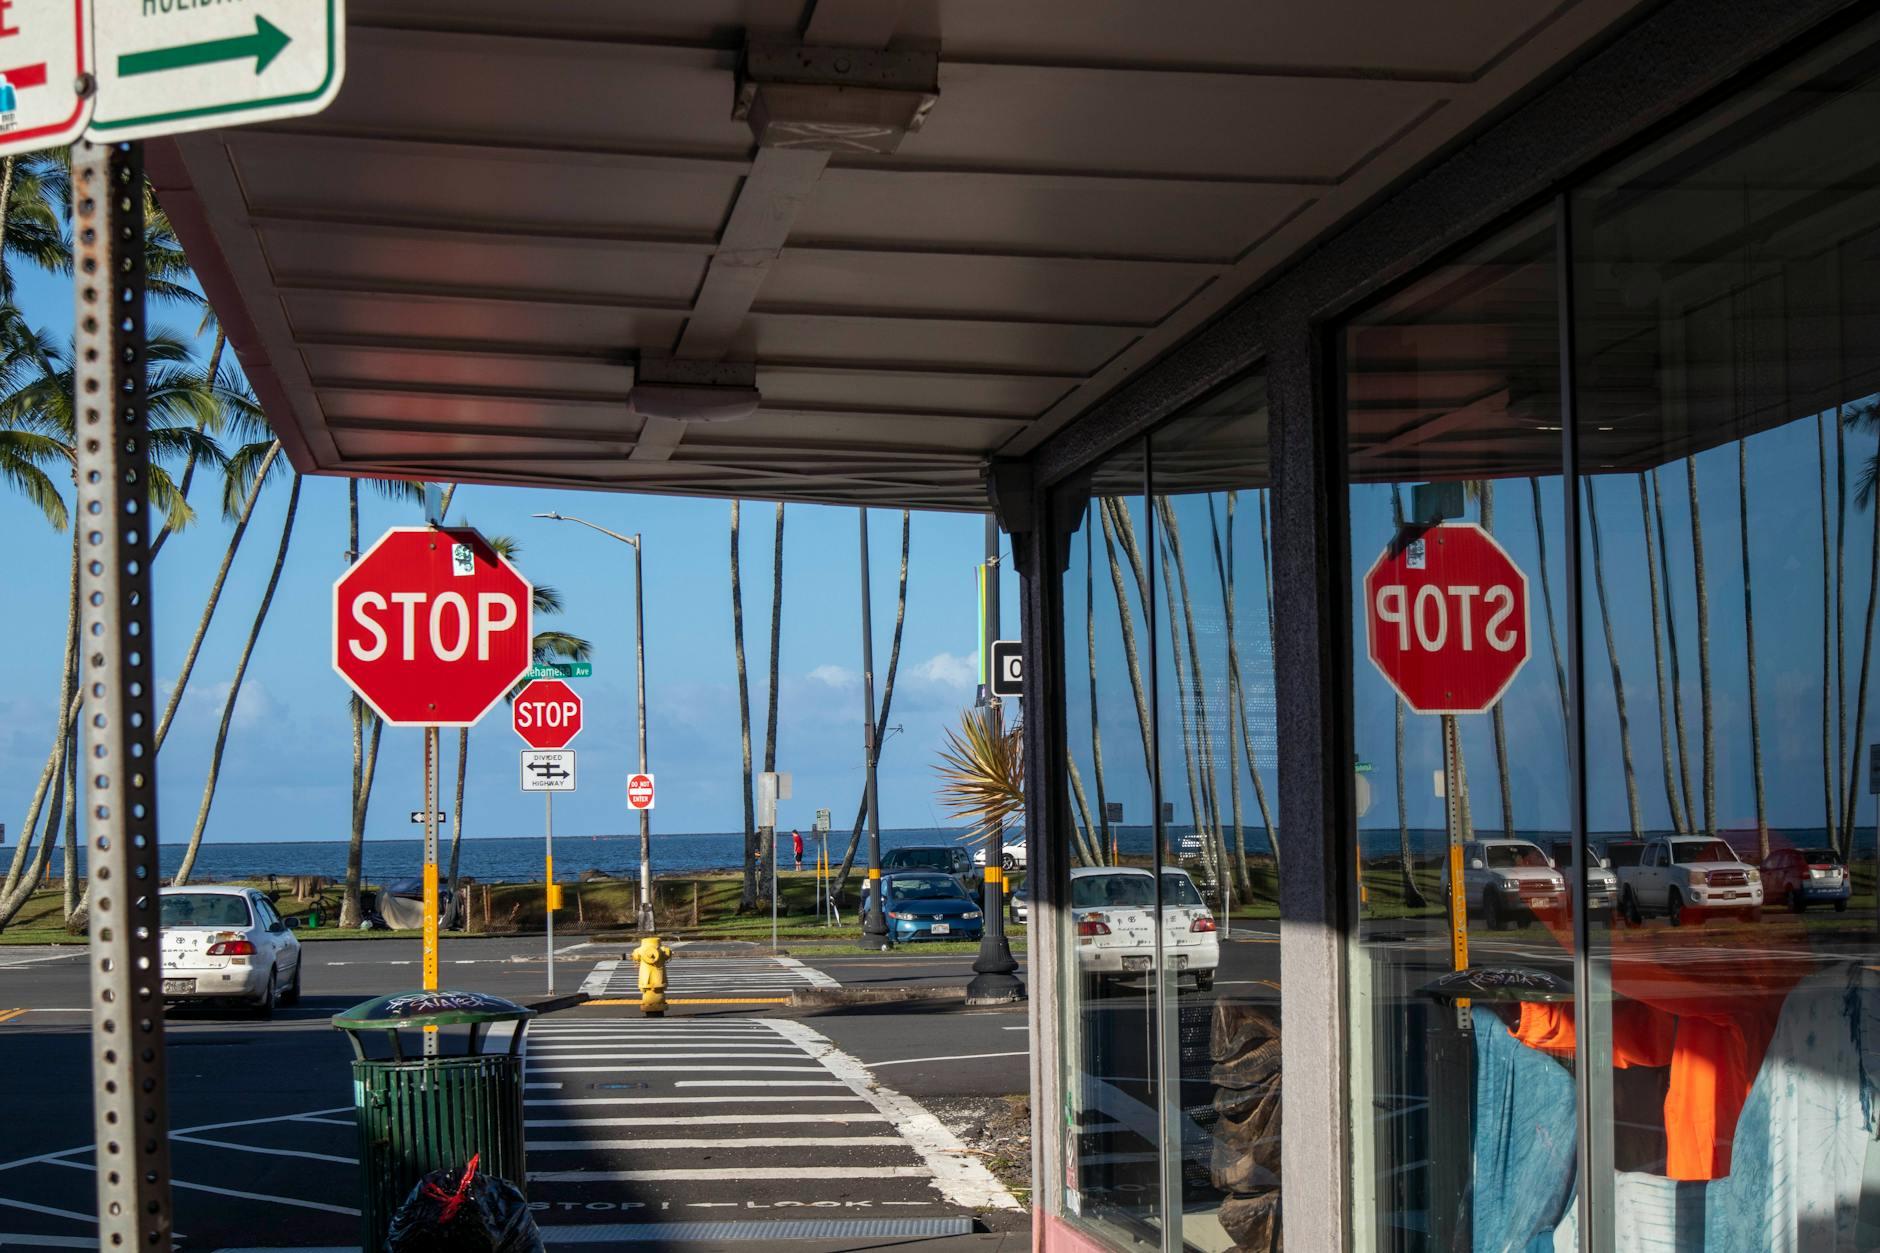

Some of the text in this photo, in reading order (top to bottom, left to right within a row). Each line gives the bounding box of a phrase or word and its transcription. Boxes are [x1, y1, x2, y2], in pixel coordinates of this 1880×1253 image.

[348, 591, 518, 662] STOP
[576, 667, 589, 676] Ave
[518, 701, 577, 727] STOP
[747, 1200, 873, 1208] LOOK
